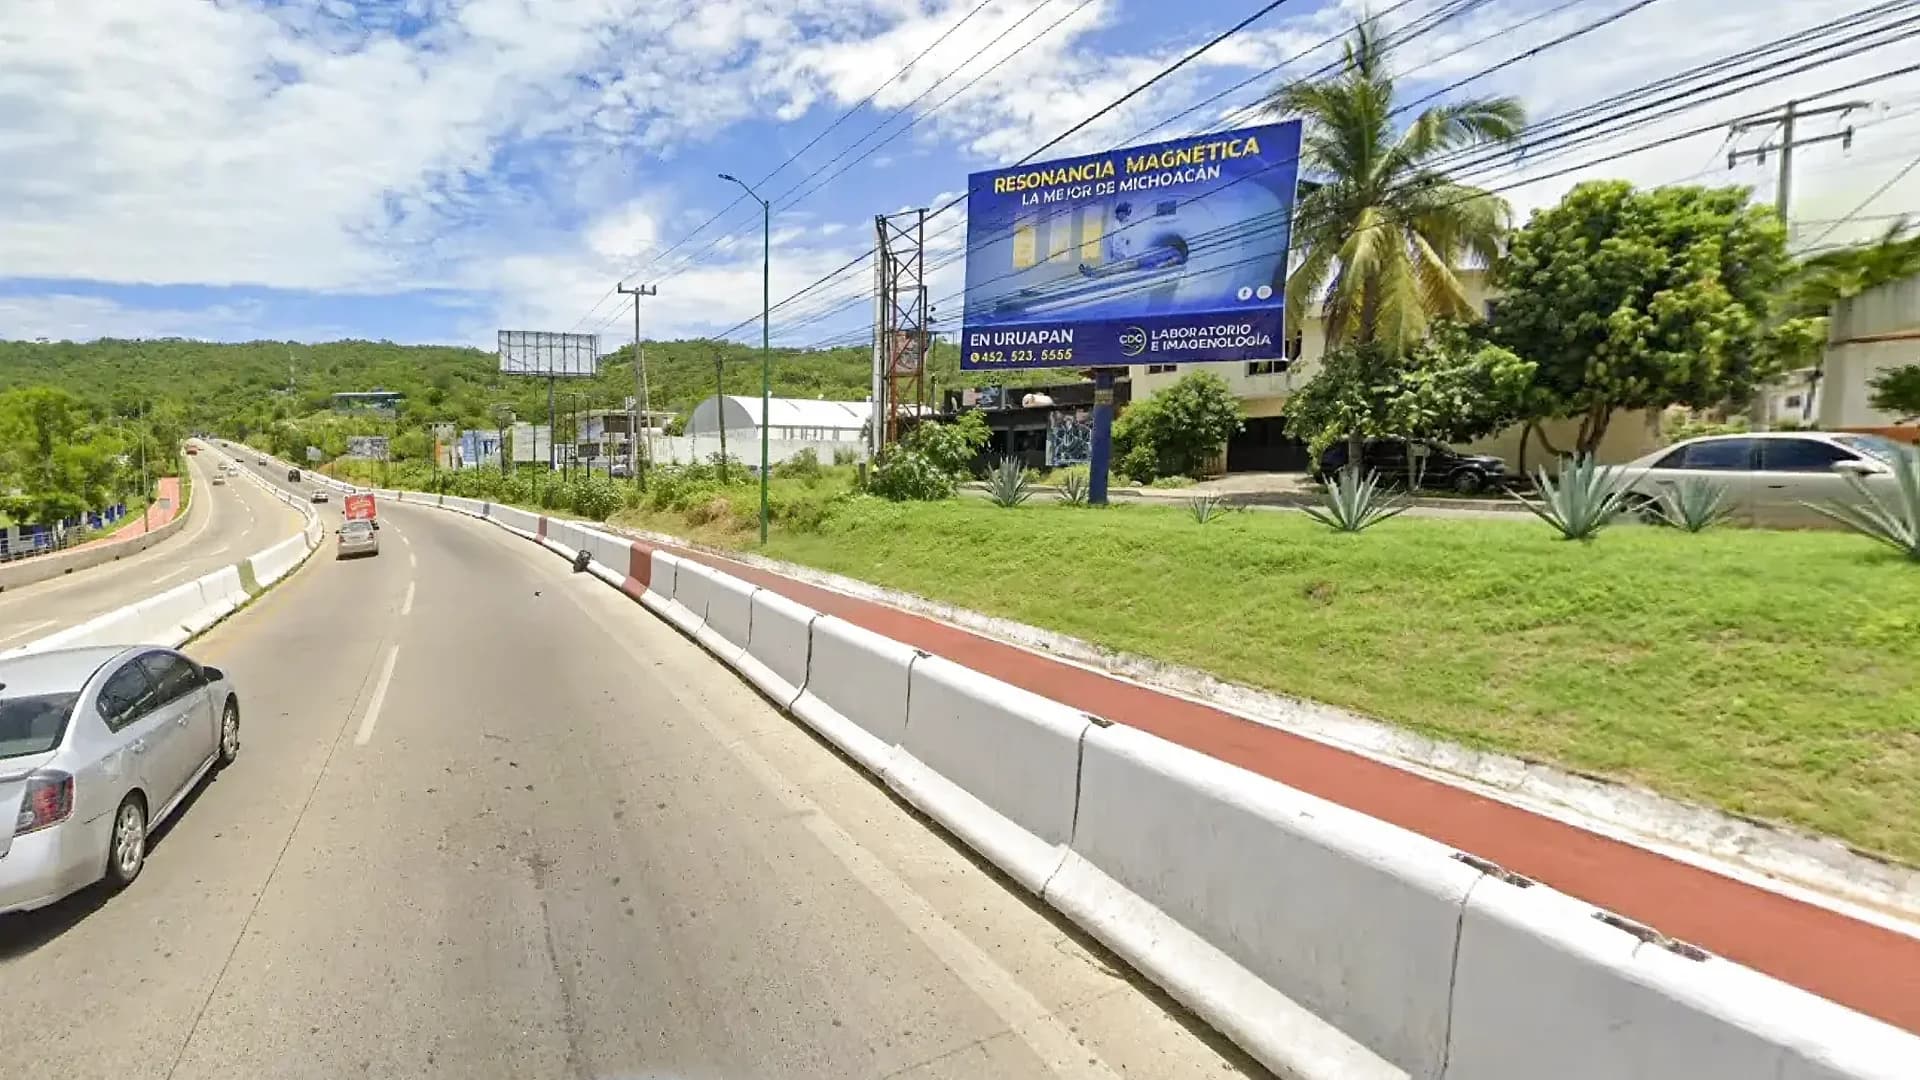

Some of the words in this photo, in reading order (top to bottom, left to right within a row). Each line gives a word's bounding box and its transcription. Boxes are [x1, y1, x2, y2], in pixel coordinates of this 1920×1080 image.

[994, 159, 1115, 194] RESONANCIA
[1125, 136, 1260, 174] MAGNÉTICA
[1022, 192, 1039, 206] LA
[1043, 184, 1092, 204] MEJOR
[1096, 180, 1115, 196] DE
[1119, 164, 1221, 192] MICHOACÁN
[970, 333, 990, 347] EN
[994, 328, 1074, 346] URUAPAN
[1151, 324, 1251, 340] LABORATORIO
[1151, 341, 1159, 351] E
